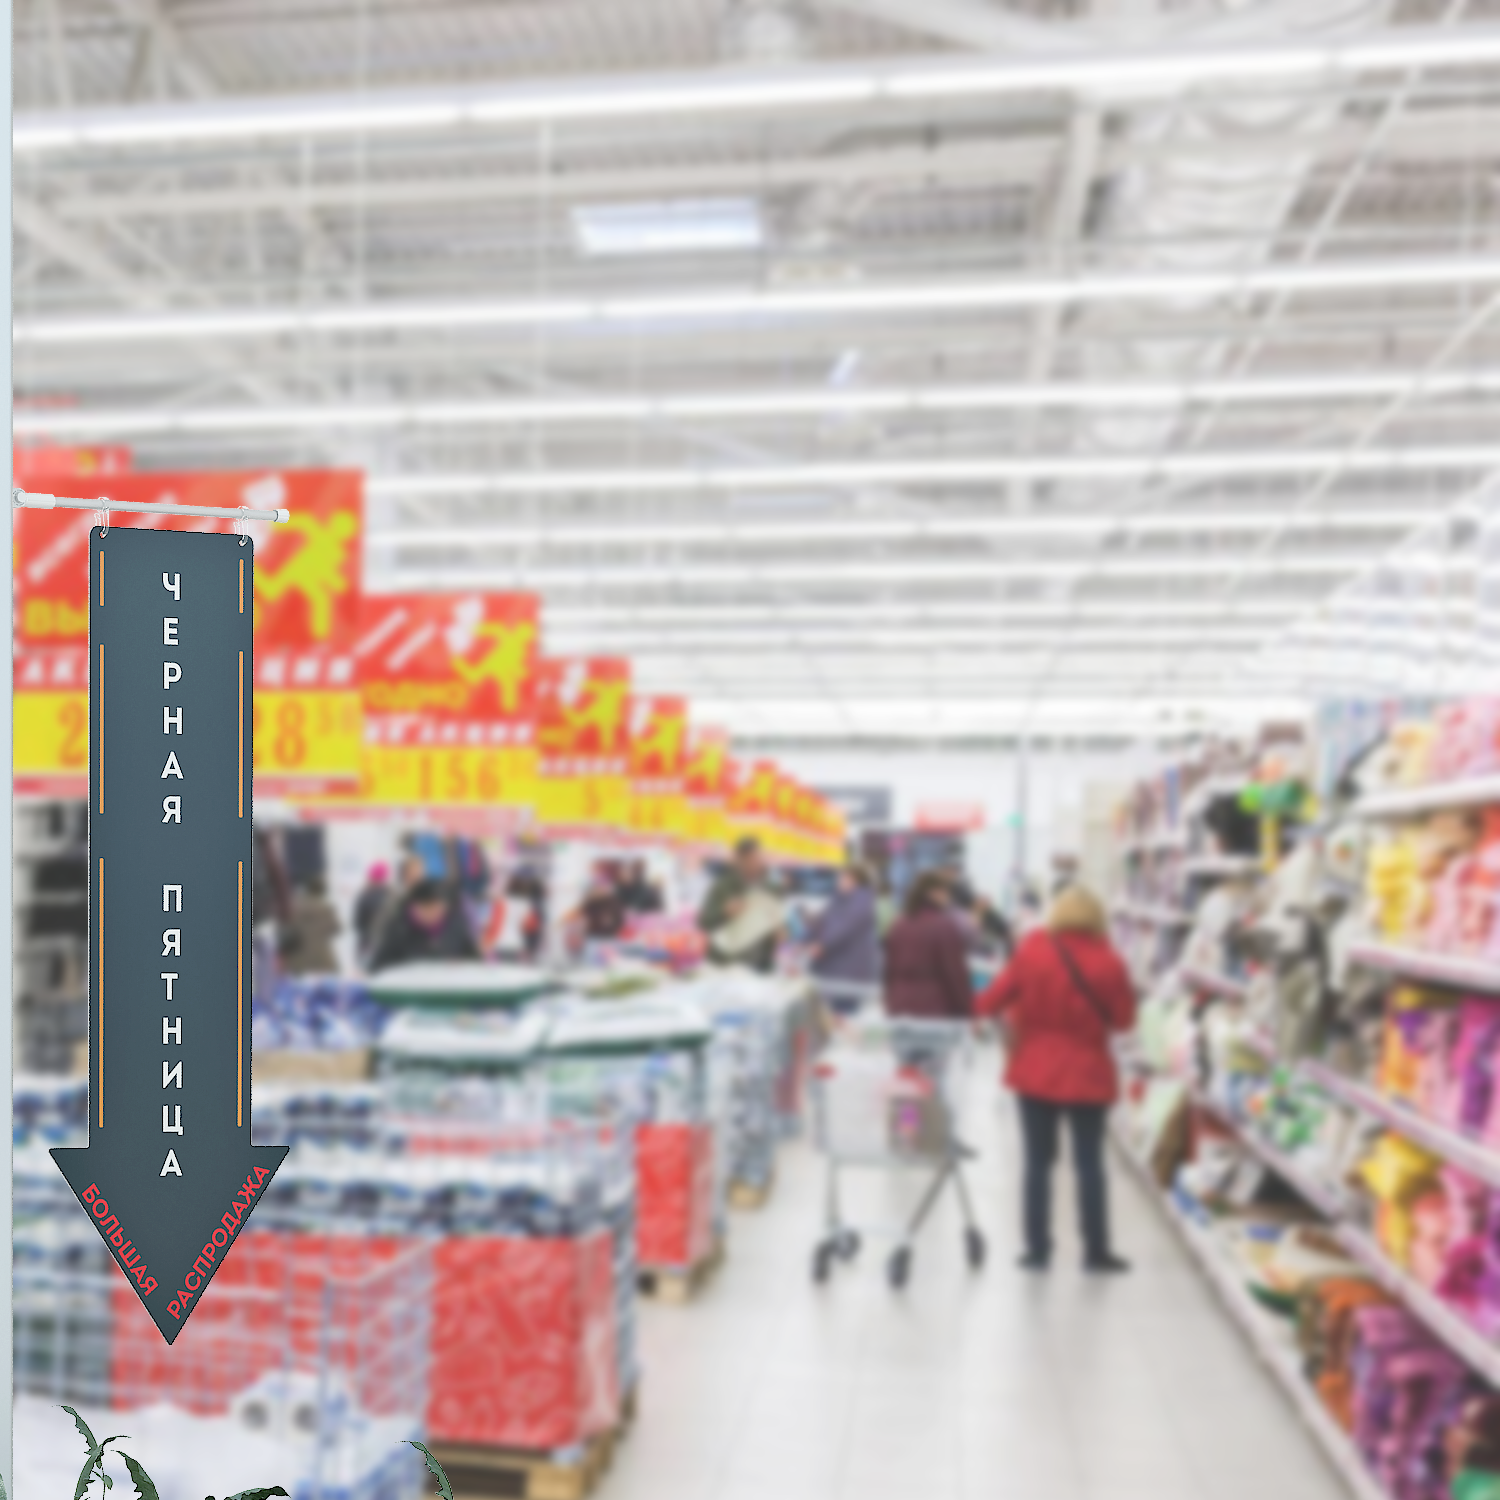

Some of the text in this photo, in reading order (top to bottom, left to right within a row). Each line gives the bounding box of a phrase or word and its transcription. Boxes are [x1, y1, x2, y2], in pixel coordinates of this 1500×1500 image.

[159, 572, 185, 1177] ЧЕРНАЯ ПЯТНИЦА
[81, 1183, 159, 1297] БОЛЬШАЯ
[166, 1166, 270, 1320] РАСПРОДАЖА
